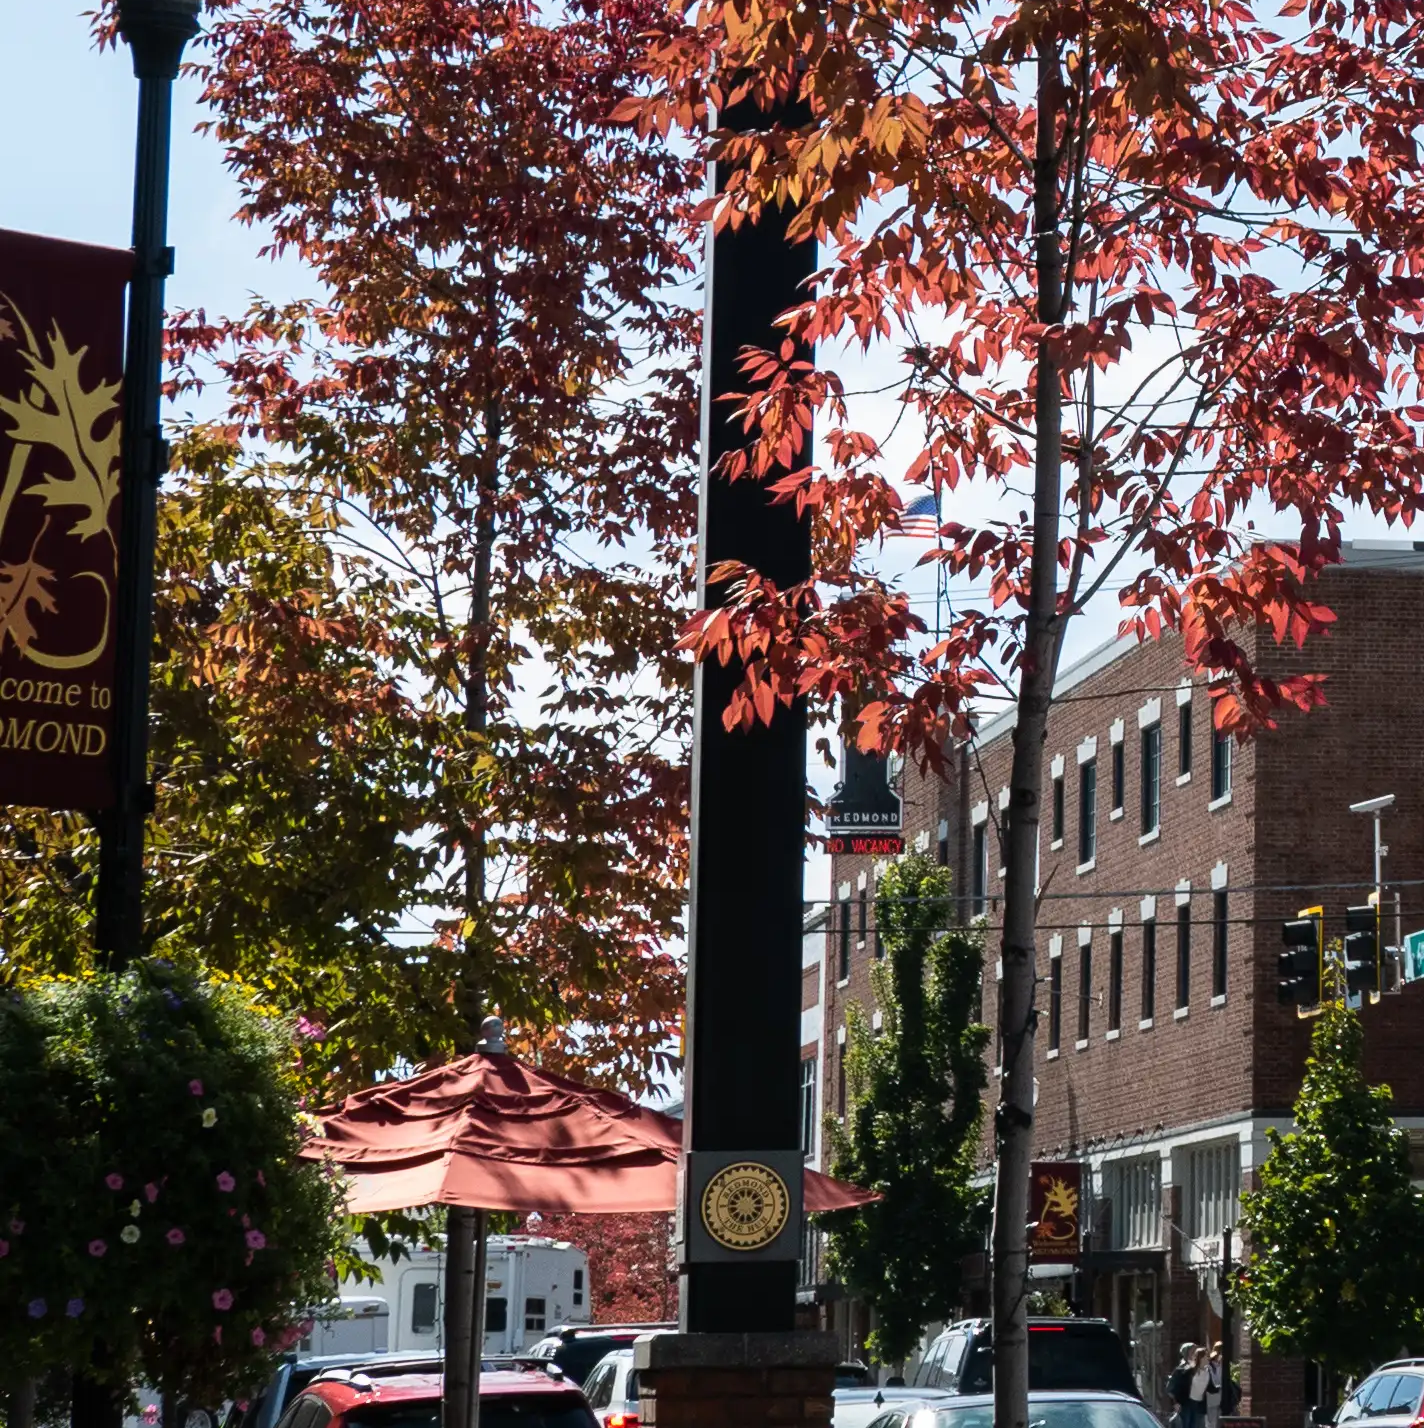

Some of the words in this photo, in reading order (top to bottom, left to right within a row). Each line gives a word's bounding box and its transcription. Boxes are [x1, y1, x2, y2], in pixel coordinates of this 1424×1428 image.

[0, 676, 81, 707] come
[91, 679, 111, 710] to
[0, 716, 106, 756] MOND
[826, 838, 844, 853] NO
[851, 838, 901, 853] VACANCY
[722, 1179, 769, 1199] REDMOND
